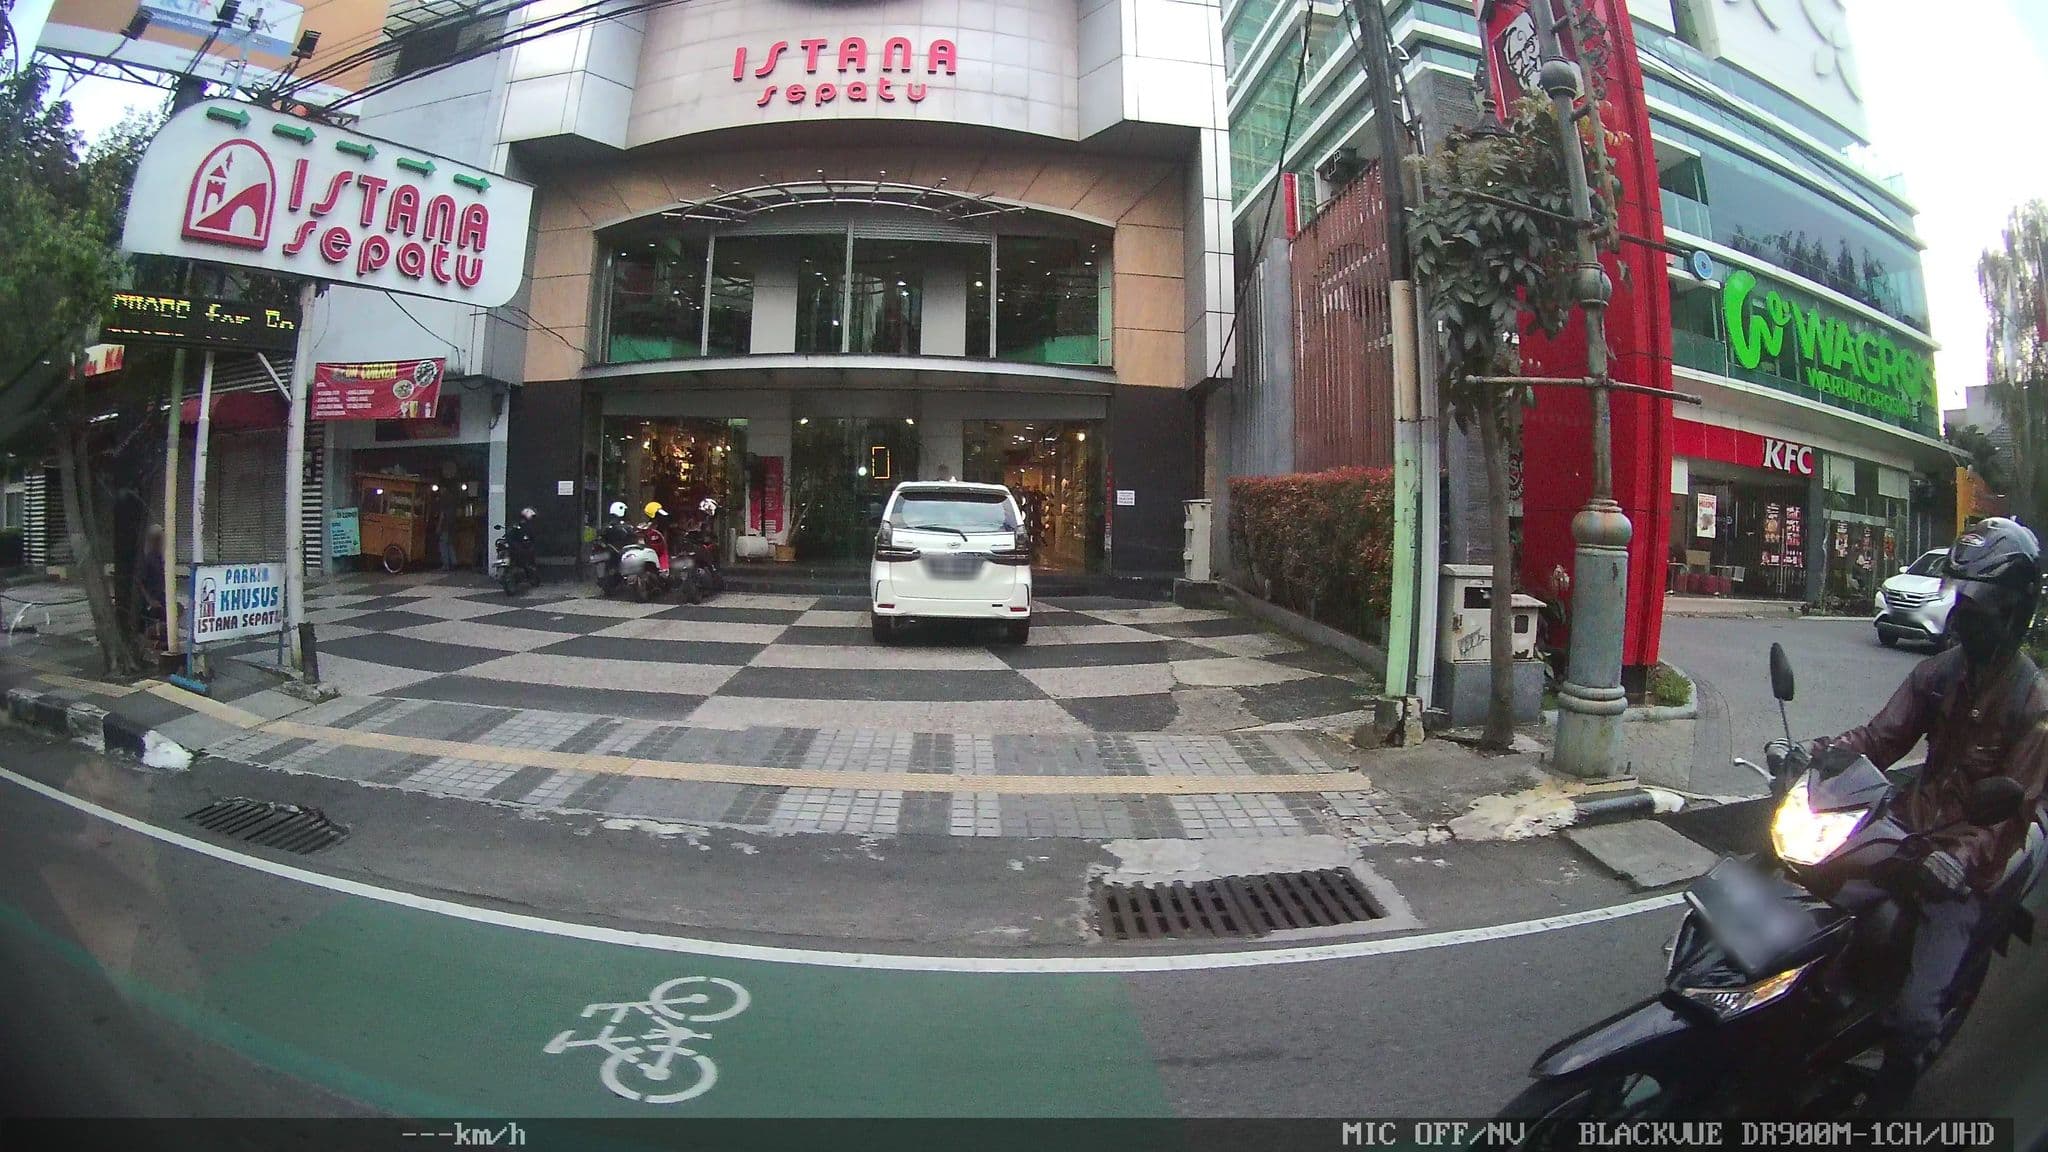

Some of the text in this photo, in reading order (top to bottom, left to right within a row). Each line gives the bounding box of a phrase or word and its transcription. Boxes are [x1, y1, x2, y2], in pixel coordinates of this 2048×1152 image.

[733, 36, 957, 81] ISTANA
[757, 77, 928, 107] sepatu
[289, 158, 490, 252] ISTANA
[283, 220, 484, 288] sepatu
[1790, 298, 1934, 402] WAGRO
[1763, 438, 1813, 475] KFC
[220, 586, 279, 612] KHUSUS
[197, 615, 238, 634] ISTANA
